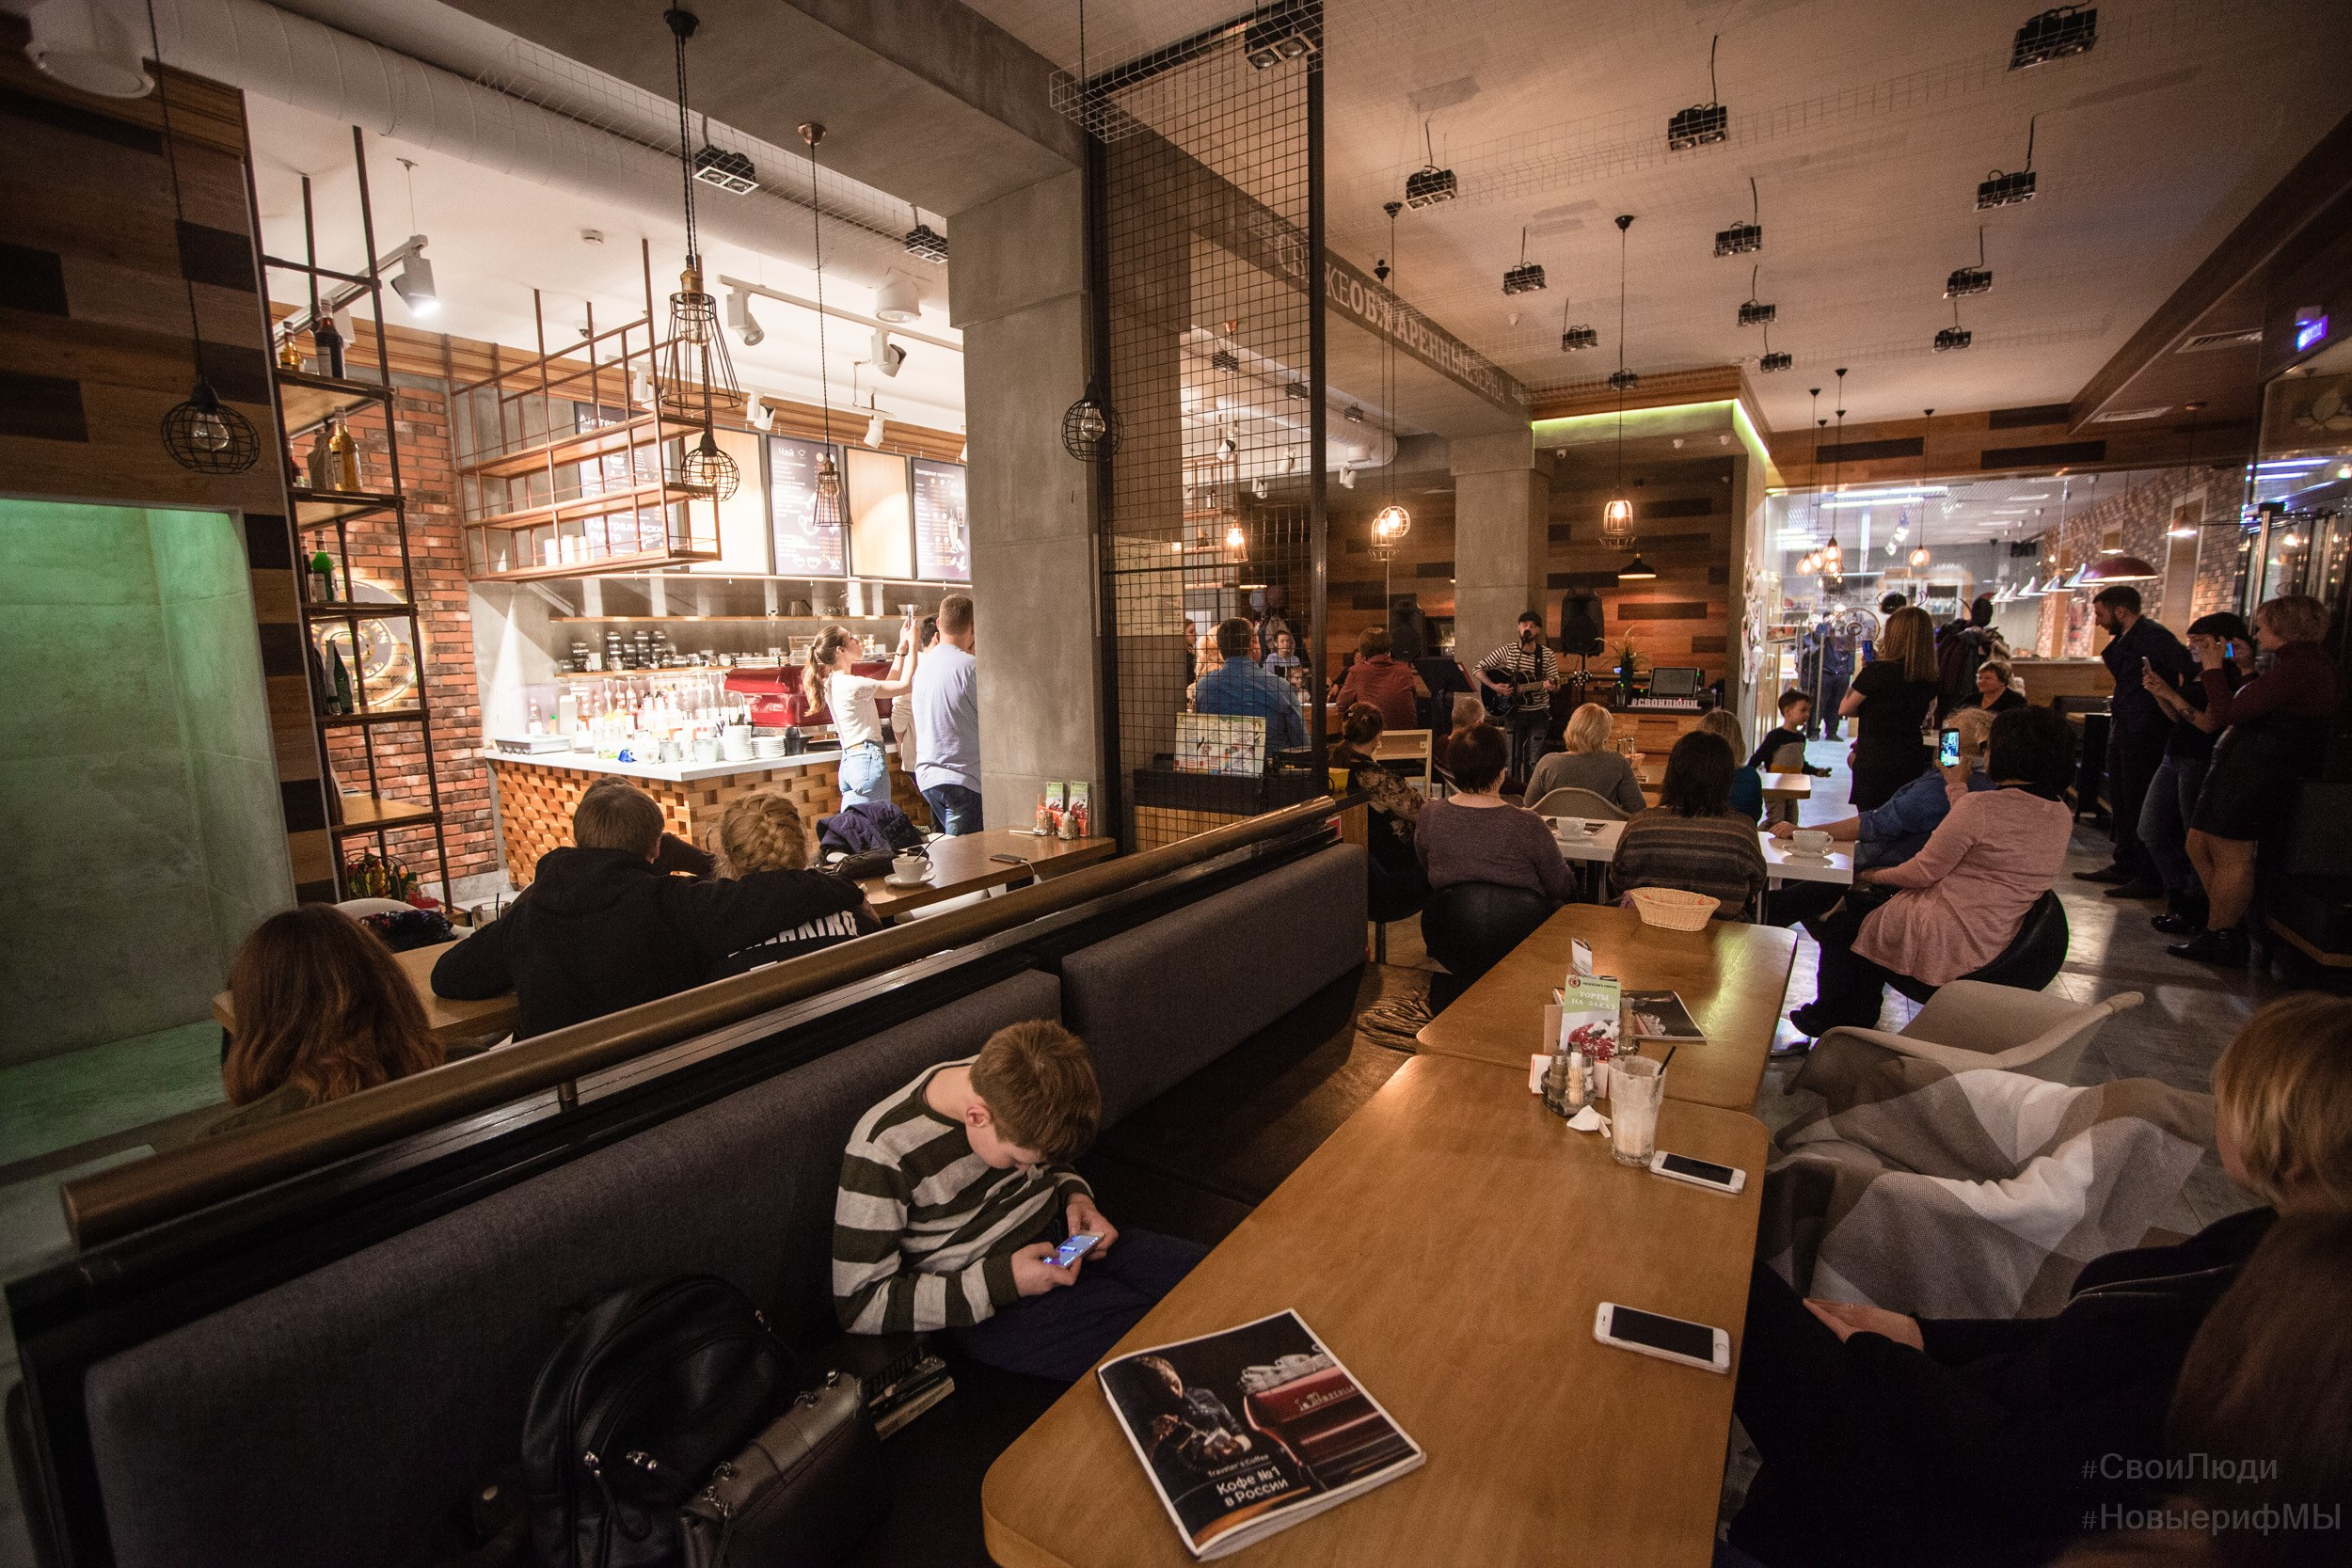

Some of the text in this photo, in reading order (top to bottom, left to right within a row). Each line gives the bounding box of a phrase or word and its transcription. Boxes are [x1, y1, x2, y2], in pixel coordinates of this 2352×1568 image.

[778, 447, 795, 458] Чай
[1580, 990, 1609, 1001] ТОРТЫ
[1588, 1000, 1615, 1010] ЗАКАЗ
[1208, 1453, 1269, 1478] Traveler's Coffee
[1216, 1465, 1281, 1496] Кофе №1
[1224, 1478, 1289, 1507] в России
